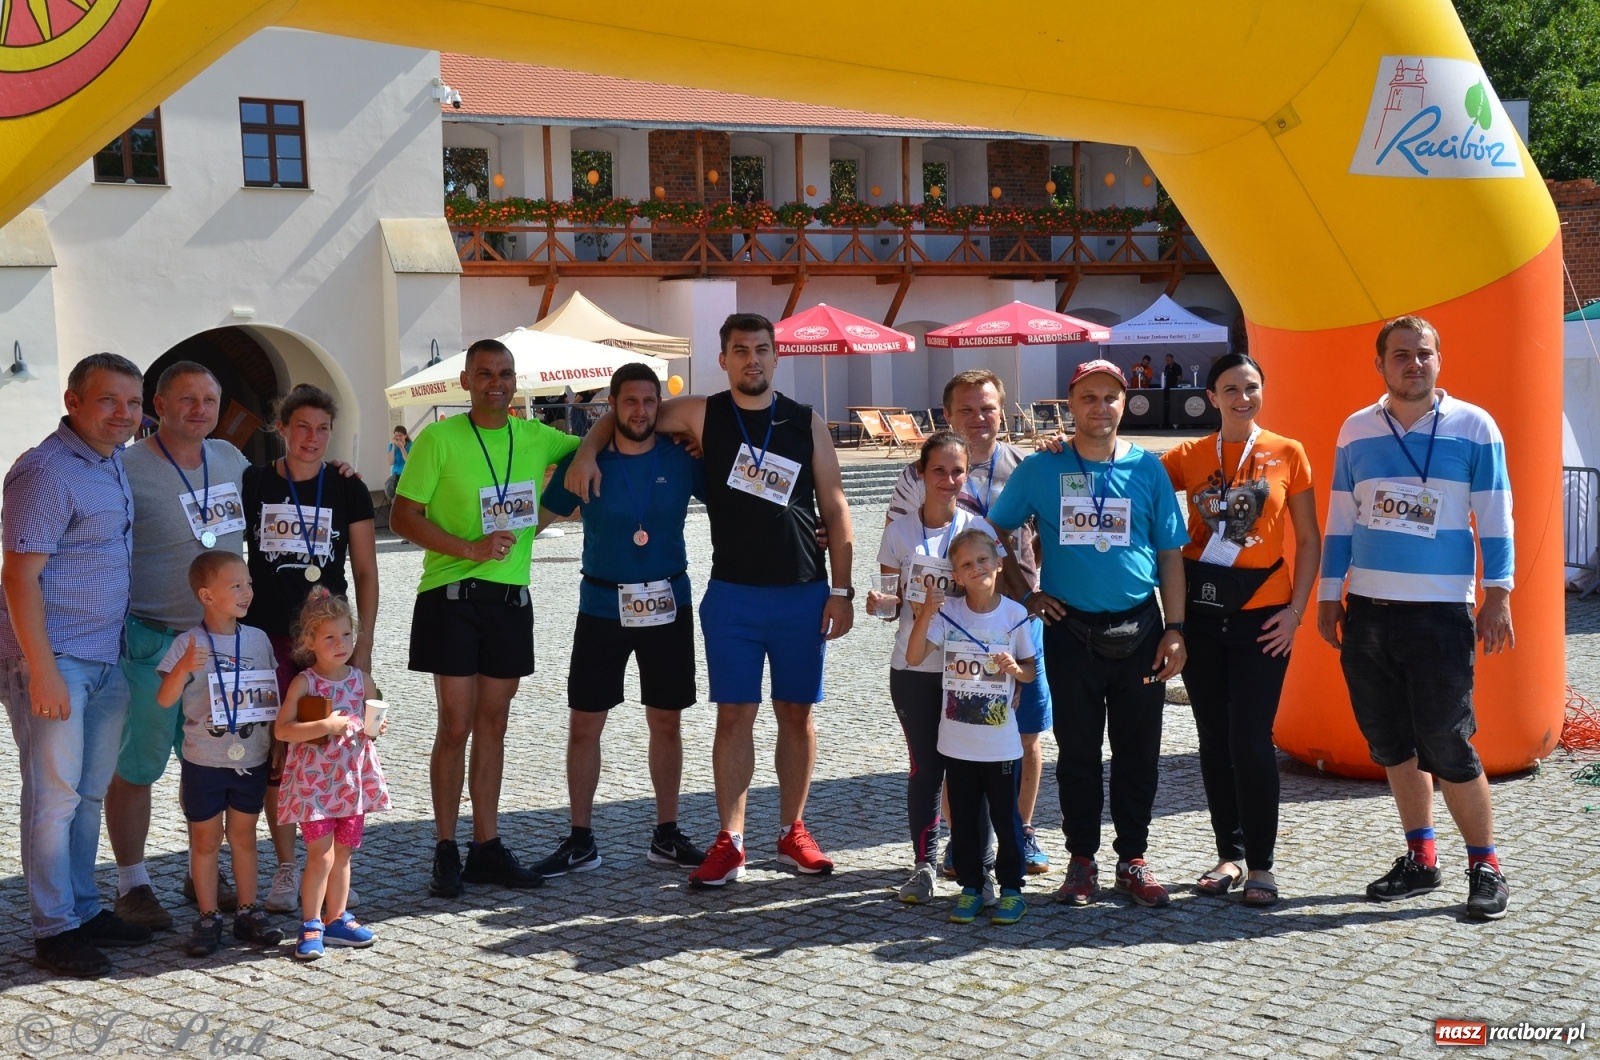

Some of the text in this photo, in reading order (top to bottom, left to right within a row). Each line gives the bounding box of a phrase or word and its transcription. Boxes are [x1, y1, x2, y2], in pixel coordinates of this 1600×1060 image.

[1376, 105, 1516, 175] Racibórz
[927, 337, 949, 347] RACIBORSKIE
[959, 336, 1013, 346] RACIBORSKIE
[1028, 333, 1081, 343] RACIBORSKIE
[778, 343, 838, 353] RACIBORSKIE
[852, 341, 900, 352] RACIBORSKIE
[540, 366, 614, 383] RACIBORSKIE
[410, 382, 448, 398] RACIBORSKIE
[747, 464, 779, 485] 010
[492, 498, 524, 517] 002
[1383, 498, 1423, 518] 004
[1074, 512, 1114, 528] 008
[633, 596, 667, 613] 005
[231, 687, 263, 706] 011
